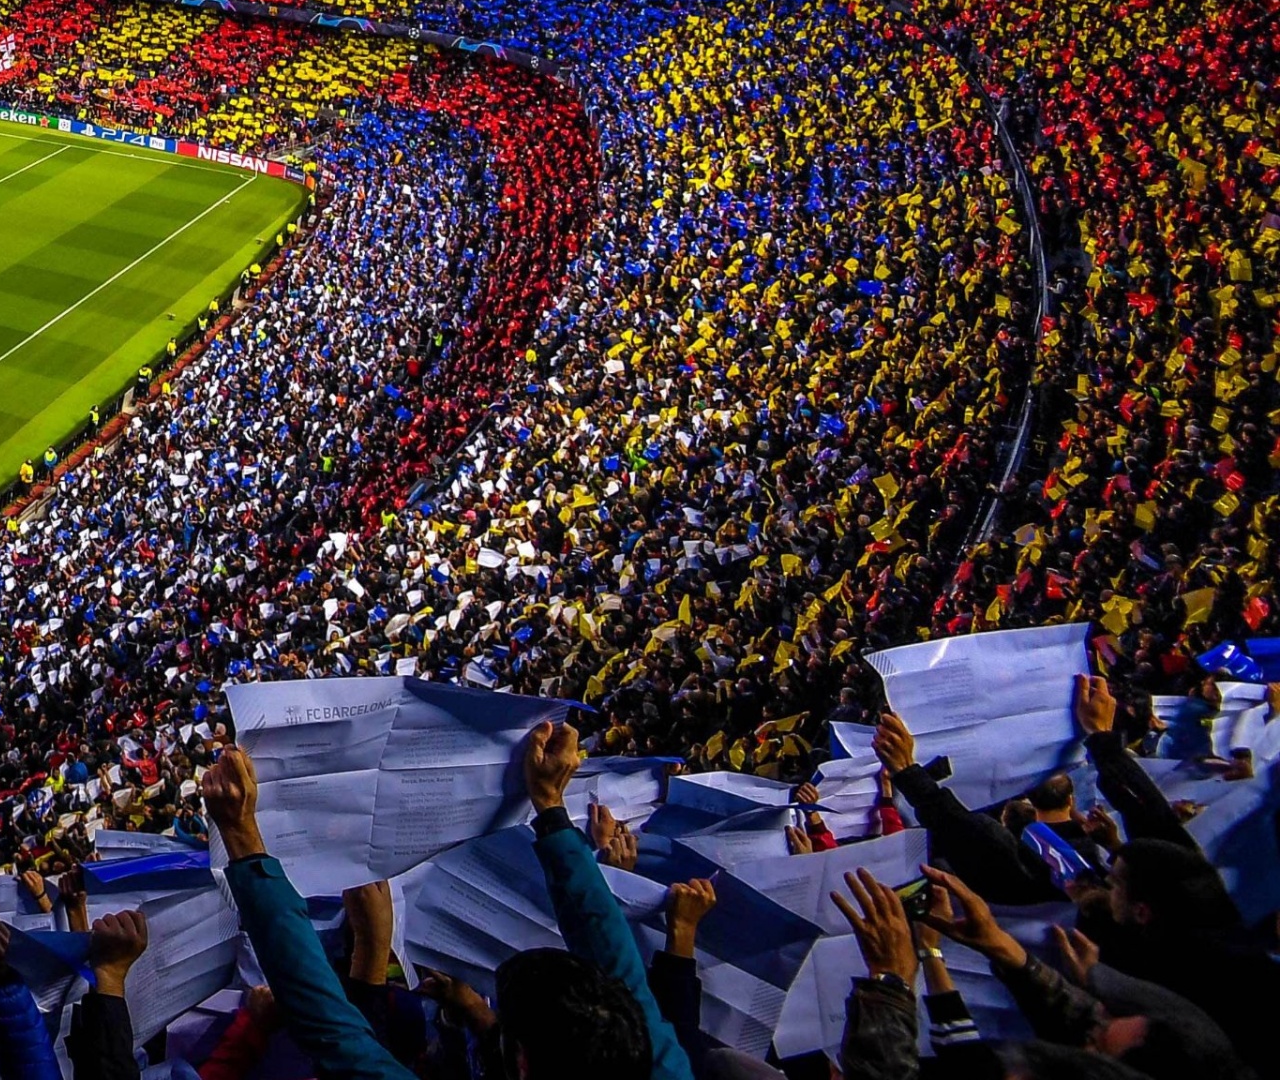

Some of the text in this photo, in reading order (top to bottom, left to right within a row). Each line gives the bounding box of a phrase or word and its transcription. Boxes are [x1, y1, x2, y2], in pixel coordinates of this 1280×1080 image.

[101, 127, 146, 146] PS4
[197, 147, 268, 173] NISSAN
[306, 698, 393, 722] FC BARCELONA
